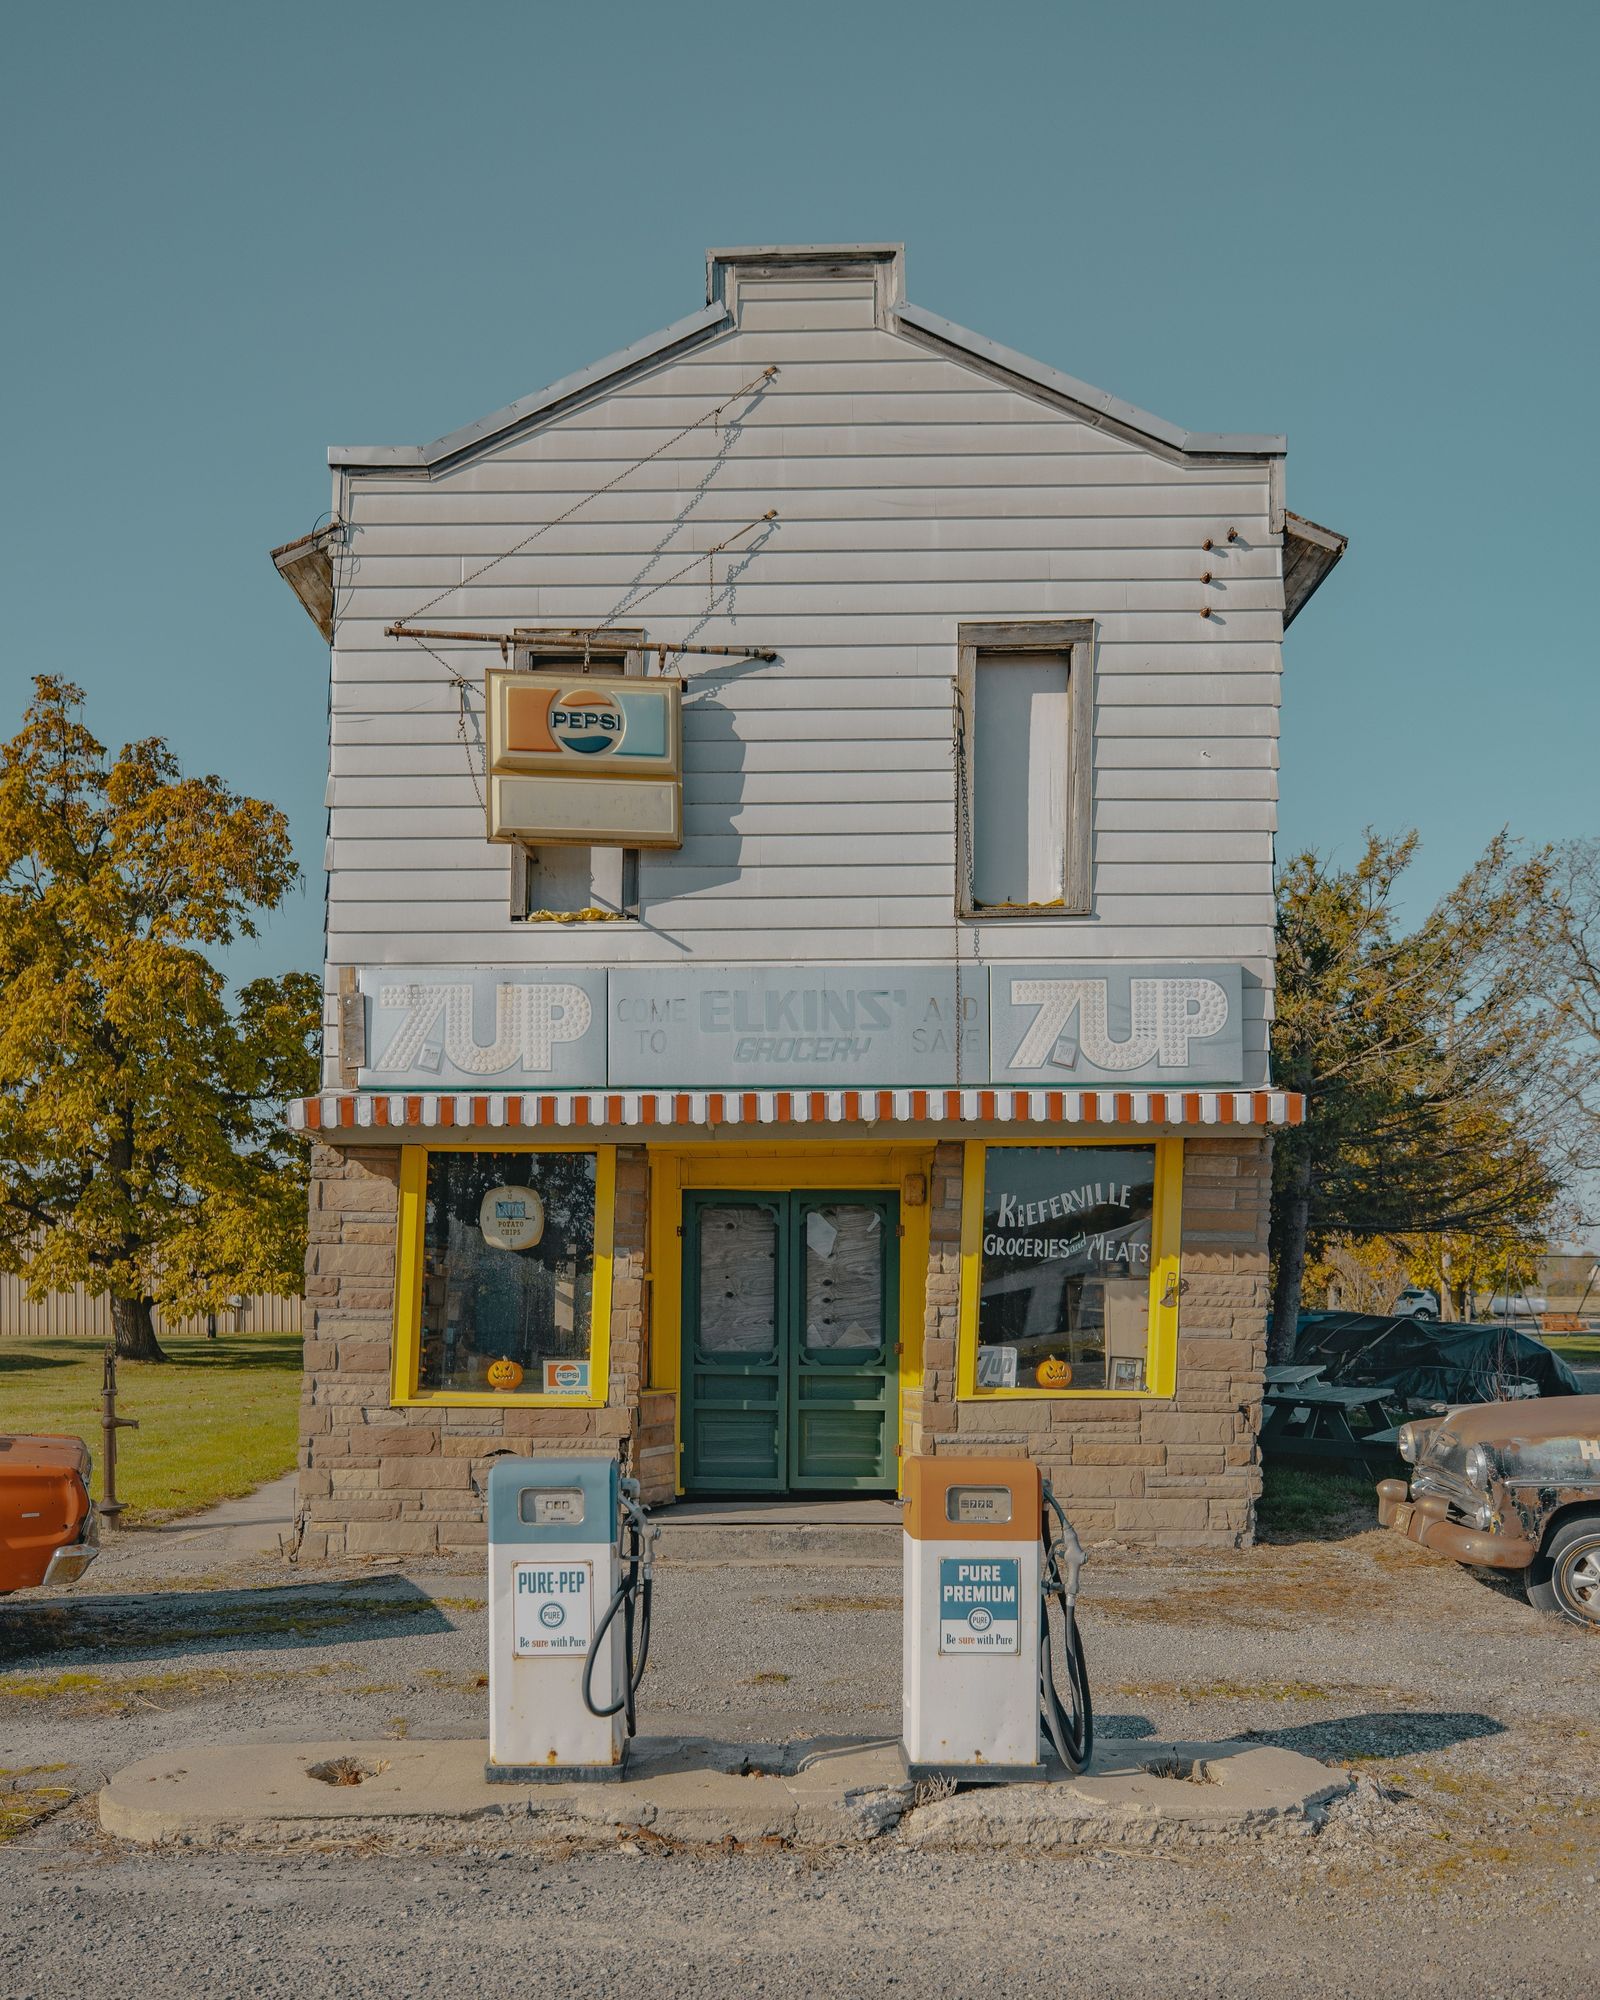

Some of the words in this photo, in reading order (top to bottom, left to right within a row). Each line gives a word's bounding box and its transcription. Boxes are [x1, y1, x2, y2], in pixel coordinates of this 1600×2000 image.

[551, 711, 620, 730] PEPSI
[616, 998, 687, 1023] COME
[374, 982, 592, 1075] 7UP
[1007, 978, 1229, 1072] 7UP
[634, 1029, 668, 1054] TO
[733, 1037, 872, 1063] GROCERY
[997, 1182, 1131, 1228] KIEFERVILLE
[983, 1234, 1069, 1259] GROCERIES
[1087, 1233, 1149, 1263] MEATS
[958, 1565, 1001, 1581] PURE
[943, 1585, 1015, 1602] PREMIUM
[543, 1611, 561, 1620] PURE
[972, 1616, 988, 1624] PURE
[519, 1636, 530, 1648] Be
[531, 1639, 549, 1648] sure
[550, 1636, 568, 1648] with
[569, 1636, 587, 1648] Pure
[946, 1633, 956, 1645] Be
[958, 1637, 976, 1645] sure
[977, 1633, 994, 1645] with
[995, 1633, 1013, 1645] Pure
